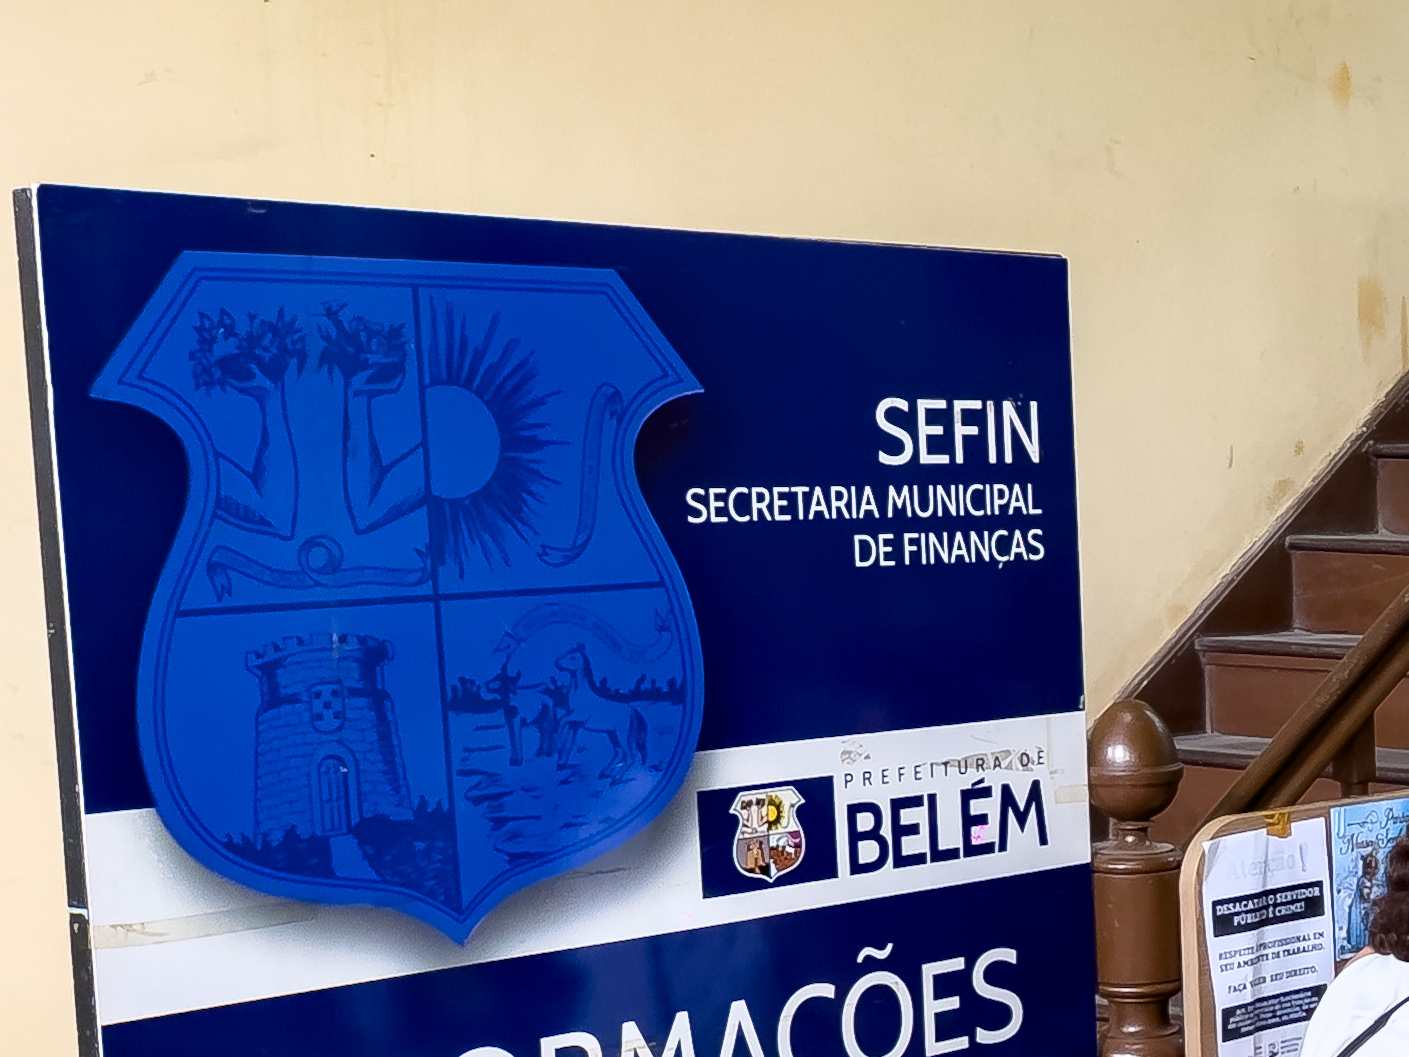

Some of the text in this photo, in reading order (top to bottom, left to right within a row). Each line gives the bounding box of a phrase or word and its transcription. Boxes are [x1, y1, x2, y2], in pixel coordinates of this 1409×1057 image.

[875, 397, 1041, 466] SEFIN
[685, 483, 1043, 524] SECRETARIA MUNICIPAL
[853, 528, 1045, 570] DE FINANÇAS
[843, 749, 1046, 789] PREFEITURA DE
[846, 777, 1050, 876] BELÉM
[1275, 887, 1320, 904] SERVIDOR
